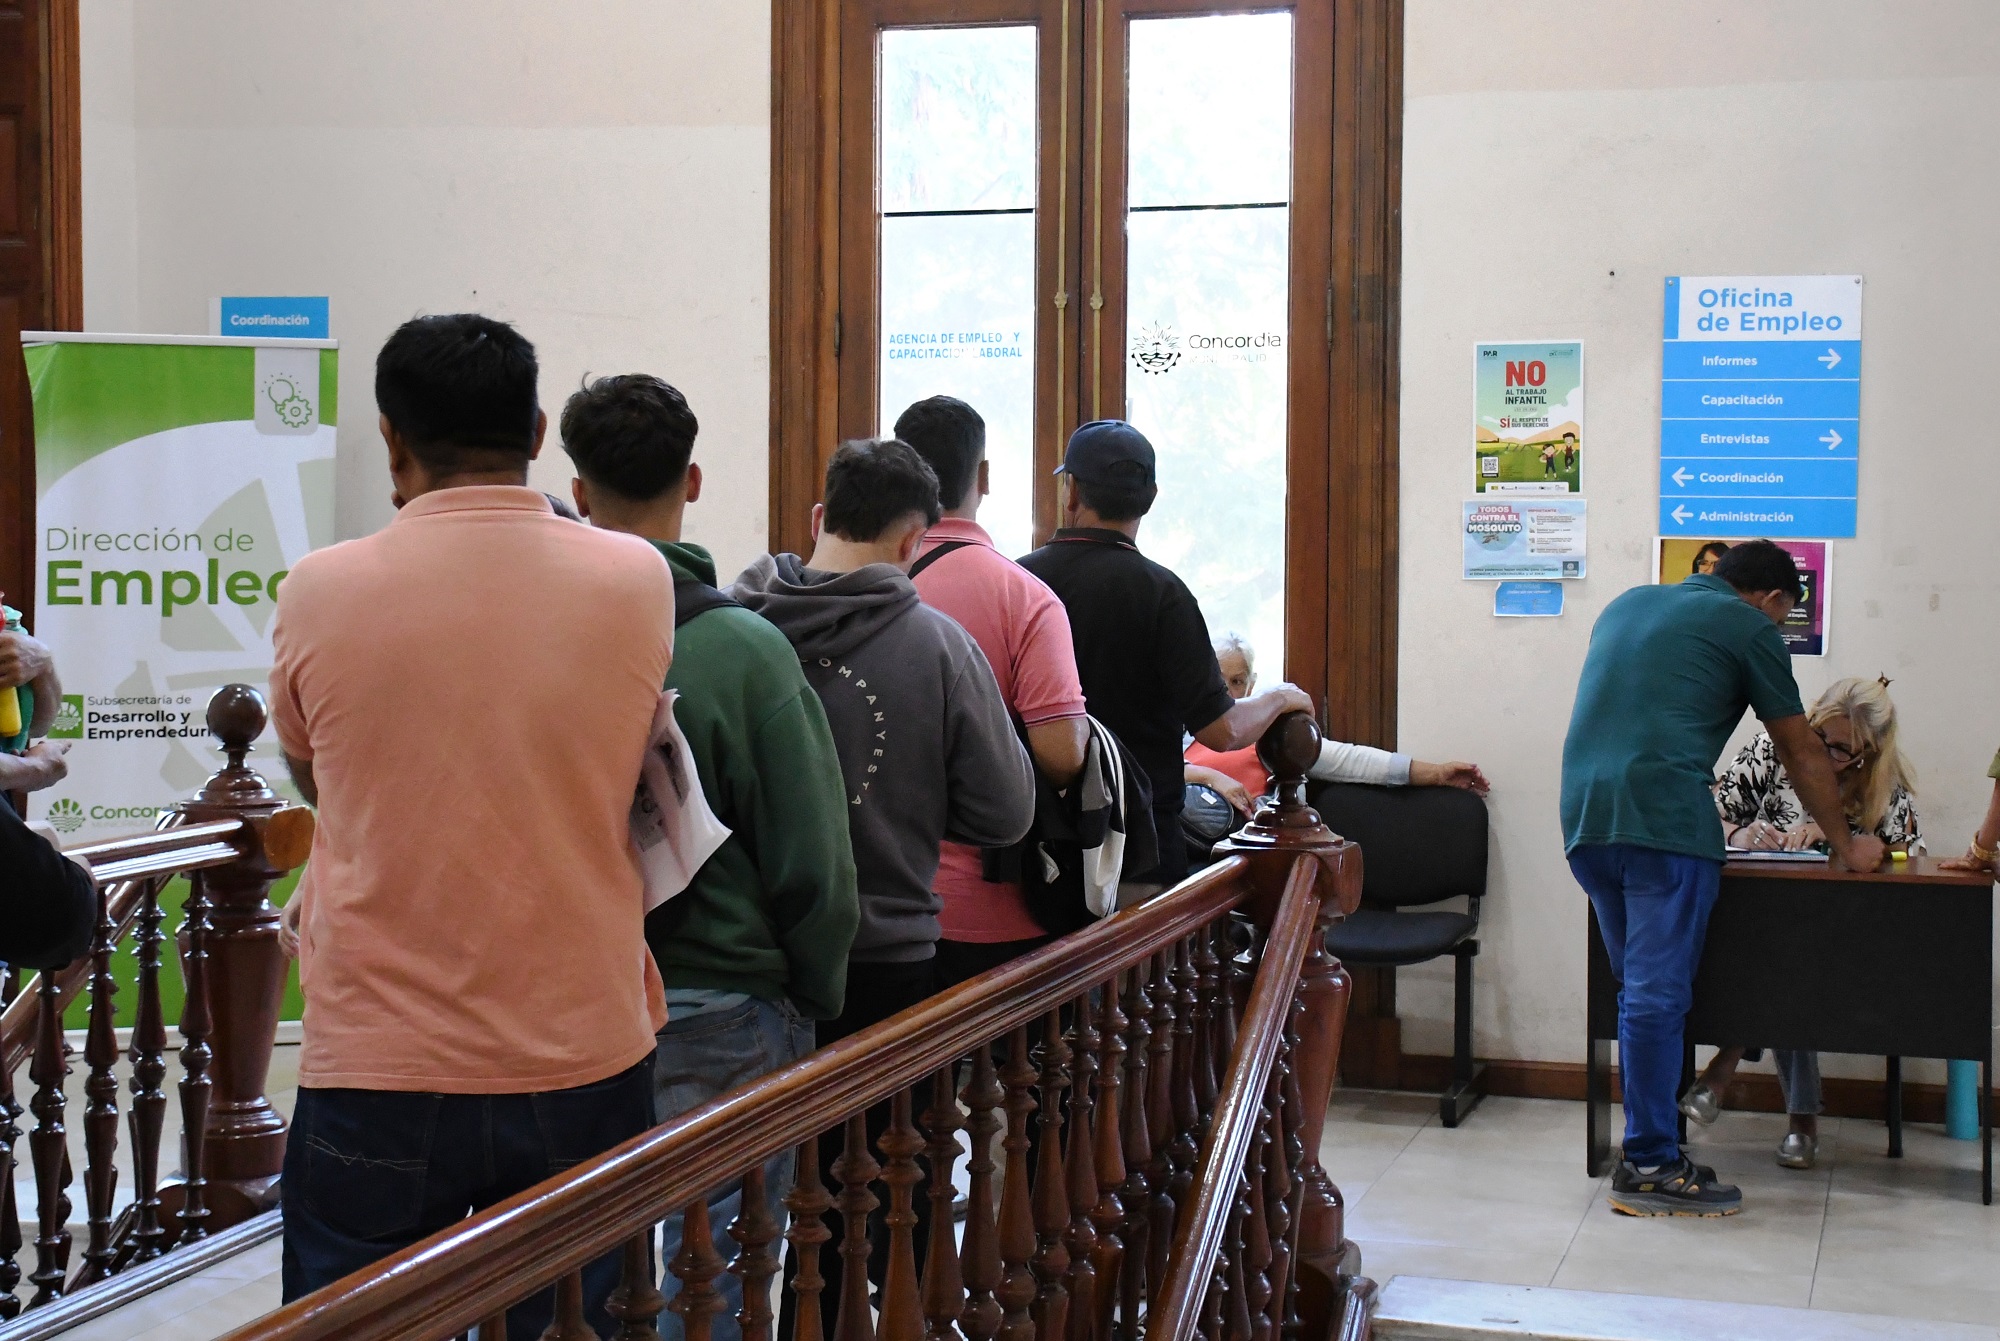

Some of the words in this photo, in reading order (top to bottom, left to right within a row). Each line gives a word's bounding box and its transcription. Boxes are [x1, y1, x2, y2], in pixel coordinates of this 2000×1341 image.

[1698, 288, 1793, 307] Oficina
[230, 314, 309, 326] Coordinación
[1697, 312, 1730, 331] de
[1740, 312, 1842, 335] Empleo
[889, 334, 937, 344] AGENCIA
[941, 333, 954, 343] DE
[958, 333, 1002, 343] EMPLEO
[1013, 332, 1020, 342] Y
[1189, 332, 1281, 349] Concordia
[1702, 356, 1757, 366] Informes
[1506, 361, 1546, 386] NO
[1505, 396, 1546, 404] INFANTIL
[1701, 394, 1783, 406] Capacitación
[1500, 415, 1511, 428] SÍ
[1700, 433, 1769, 444] Entrevistas
[1699, 472, 1784, 483] Coordinación
[1470, 514, 1505, 522] CONTRA
[1508, 513, 1518, 521] EL
[1699, 511, 1794, 522] Administración
[1468, 523, 1522, 532] MOSQUITO
[46, 527, 201, 552] Dirección
[214, 528, 254, 551] de
[88, 694, 173, 706] Subsecretaría
[176, 695, 192, 704] de
[88, 710, 176, 724] Desarrollo
[181, 712, 191, 724] y
[90, 802, 178, 820] Concor
